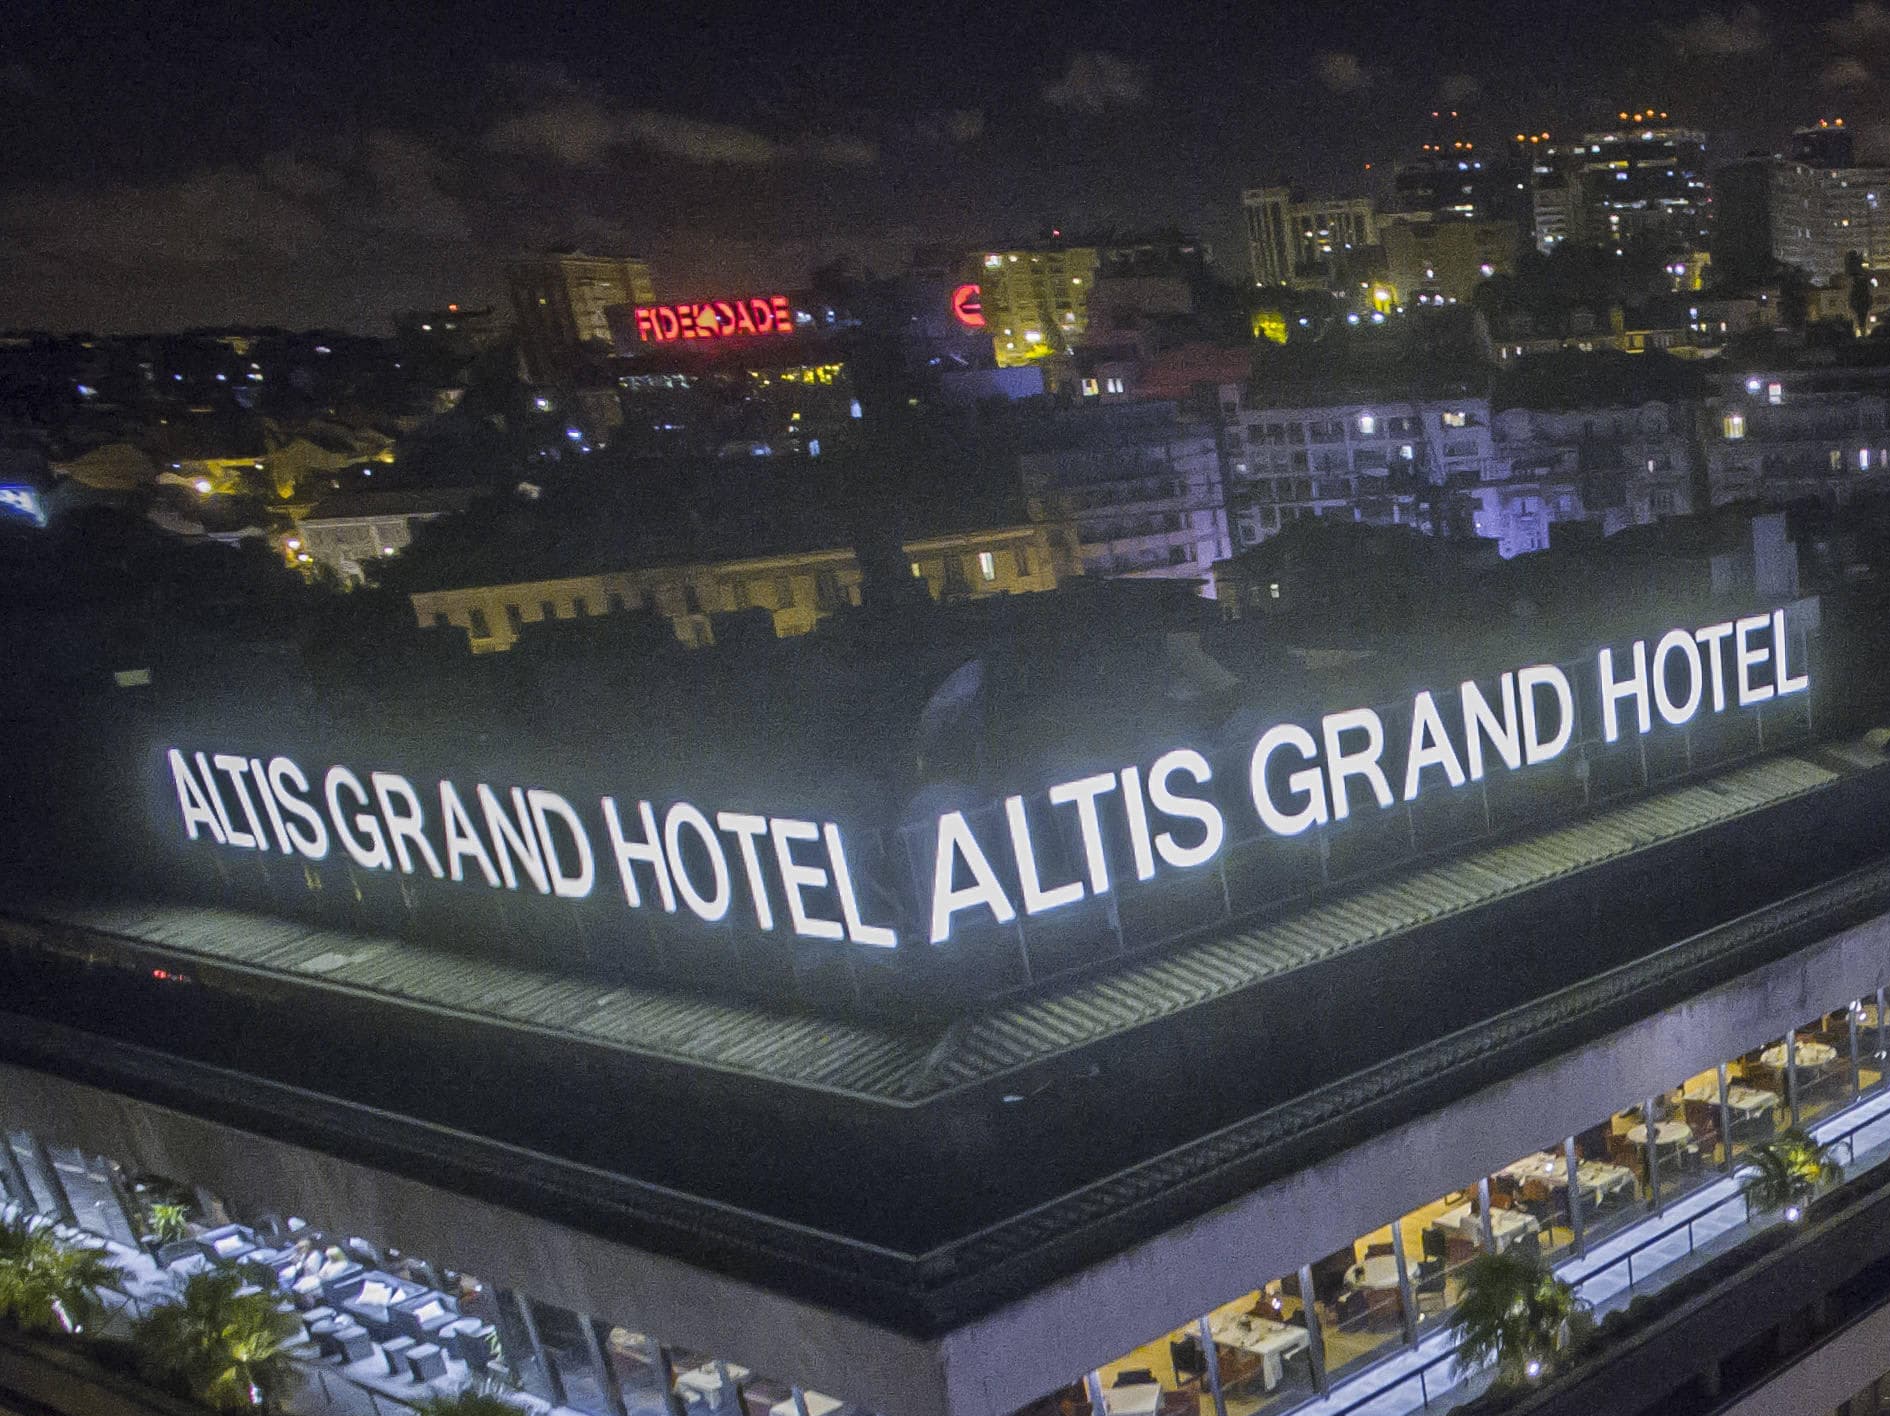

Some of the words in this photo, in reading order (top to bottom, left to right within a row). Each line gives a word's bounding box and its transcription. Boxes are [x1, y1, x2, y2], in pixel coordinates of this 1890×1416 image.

[167, 746, 329, 861] ALTIS
[325, 765, 596, 900] GRAND
[600, 795, 899, 949] HOTEL
[929, 748, 1225, 945] ALTIS
[1249, 662, 1575, 837] GRAND
[1598, 607, 1810, 744] HOTEL
